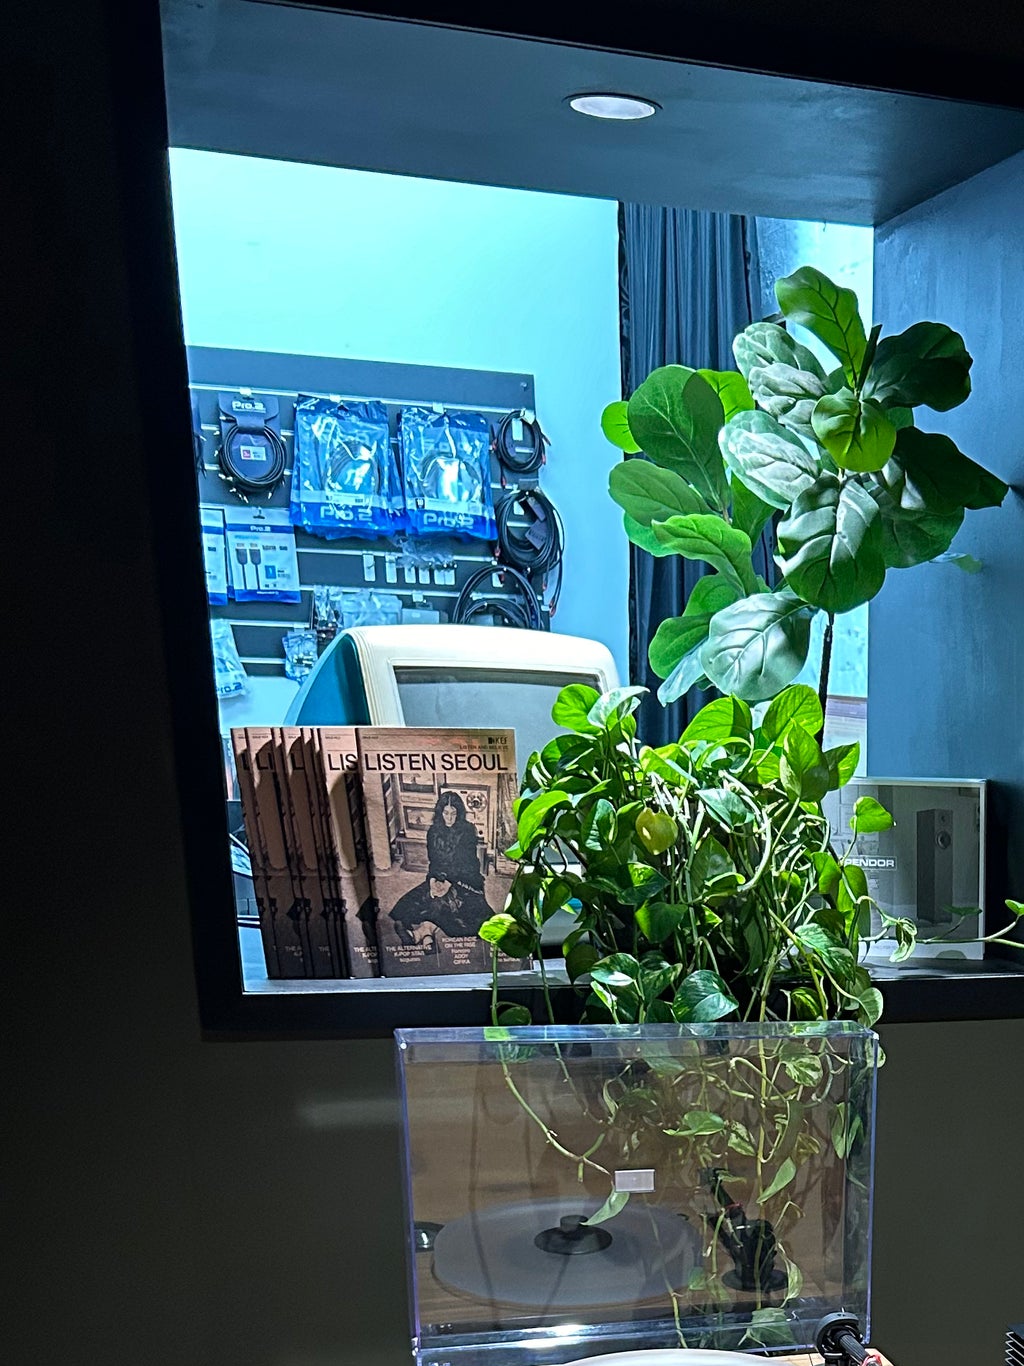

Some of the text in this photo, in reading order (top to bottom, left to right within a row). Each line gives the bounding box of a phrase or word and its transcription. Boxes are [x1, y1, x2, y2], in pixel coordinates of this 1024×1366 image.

[232, 400, 264, 410] Pro.2
[423, 513, 475, 529] Pro.2
[217, 681, 243, 694] ro.2
[327, 753, 358, 771] LIS
[364, 753, 508, 771] LISTEN SEOUL
[842, 858, 895, 867] PENDOR
